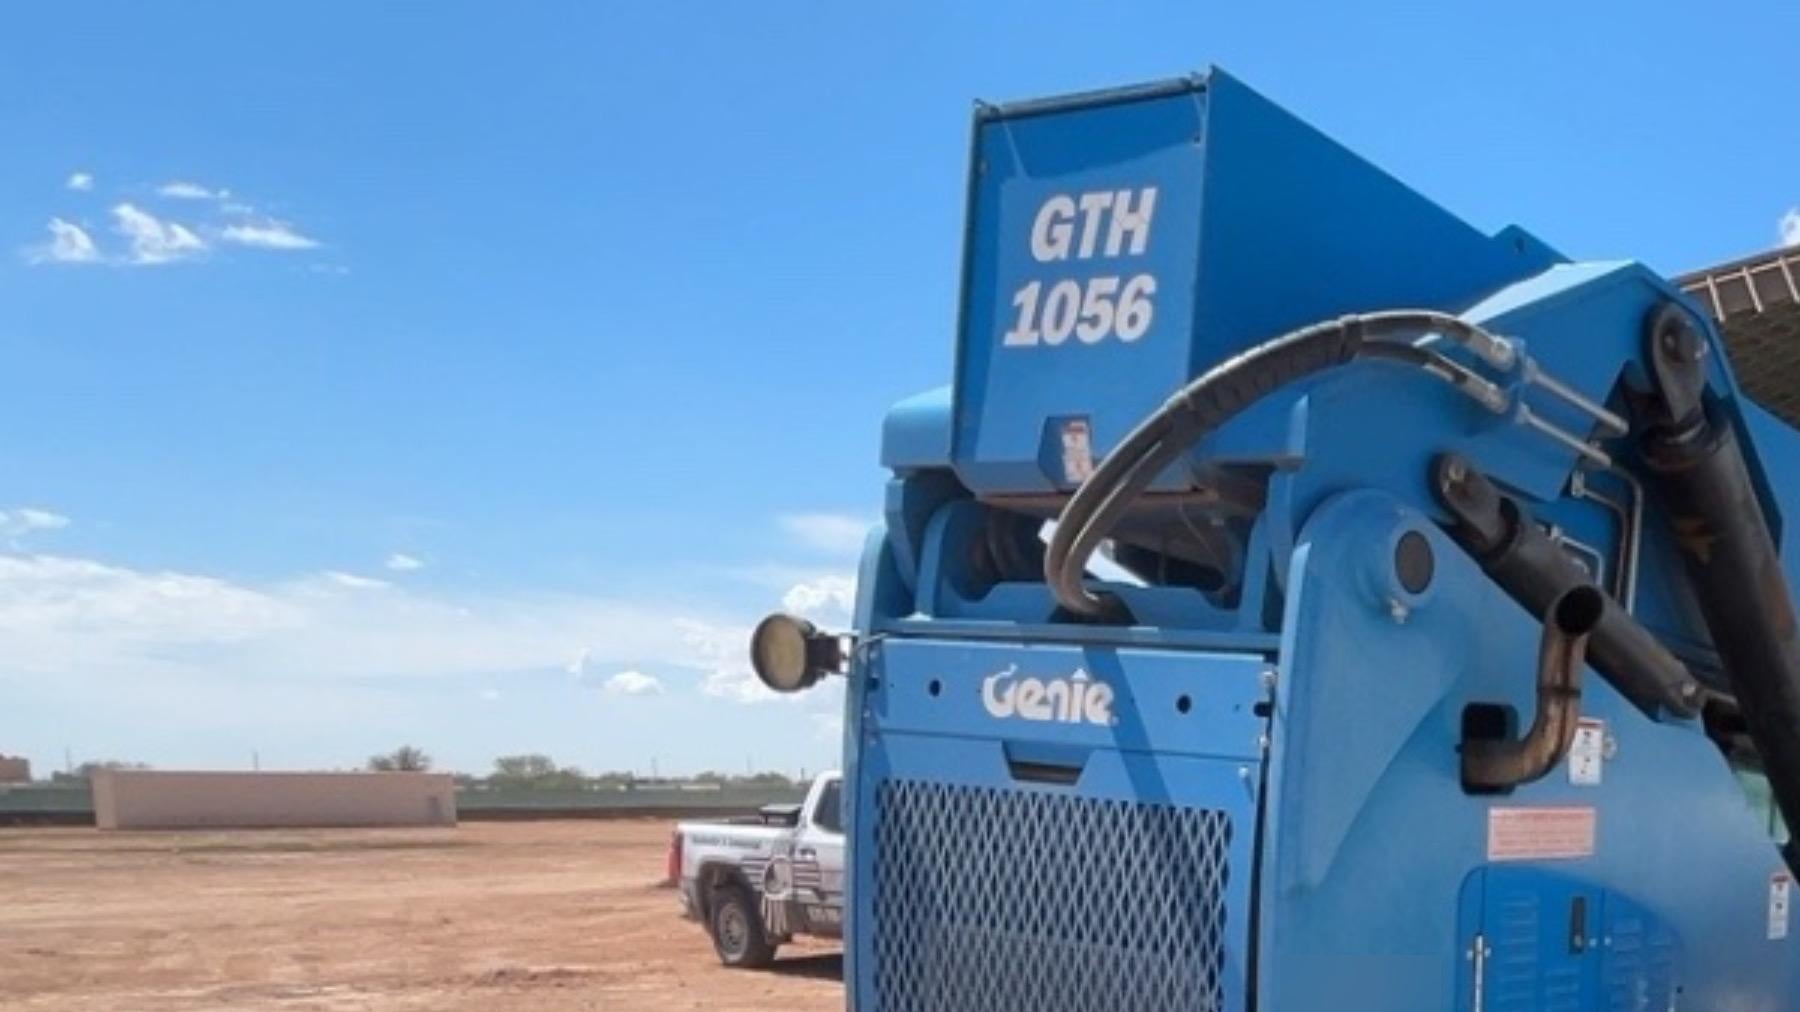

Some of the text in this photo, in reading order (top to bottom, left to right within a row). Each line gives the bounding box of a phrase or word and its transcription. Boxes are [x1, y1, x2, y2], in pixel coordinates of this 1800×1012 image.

[1031, 187, 1158, 262] GTH
[1004, 274, 1157, 346] 1056
[982, 663, 1116, 726] Genie
